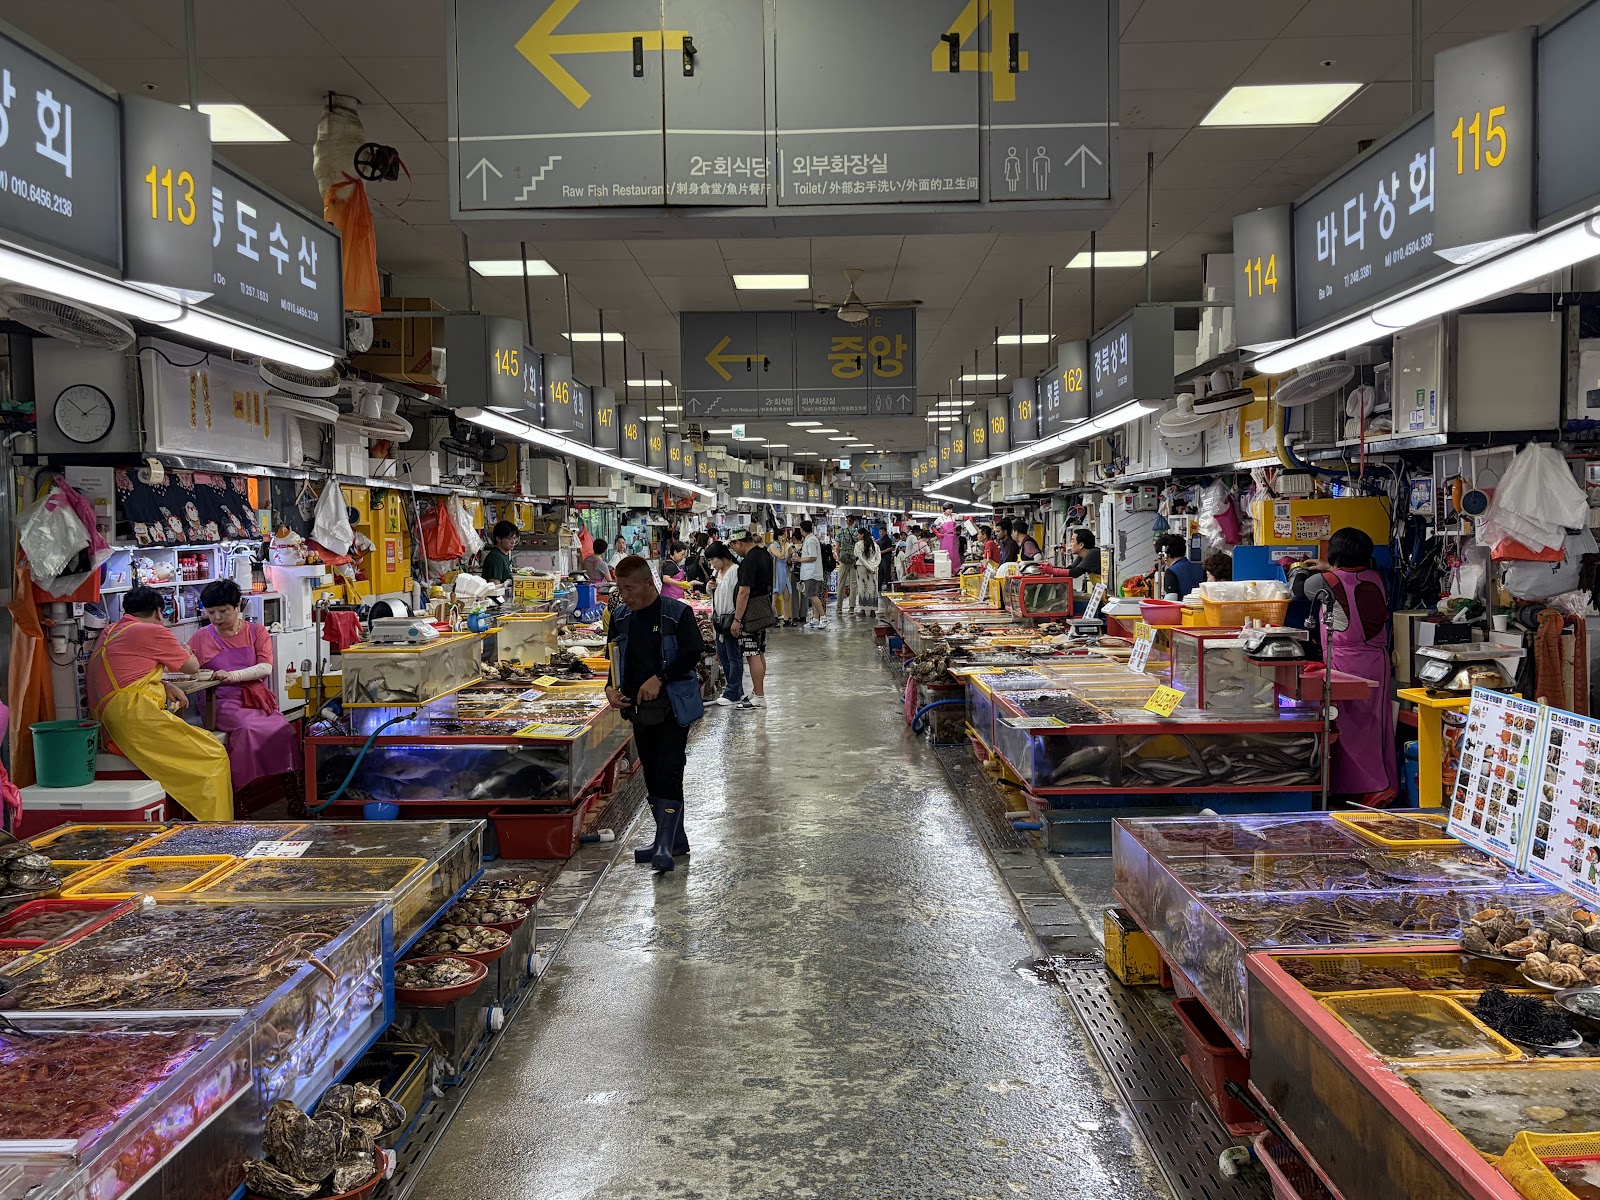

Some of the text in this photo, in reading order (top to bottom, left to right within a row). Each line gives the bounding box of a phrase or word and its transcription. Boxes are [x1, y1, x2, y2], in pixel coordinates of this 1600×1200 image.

[931, 0, 1029, 101] 4
[1451, 105, 1507, 176] 115
[690, 156, 771, 177] 2F회식당
[792, 153, 888, 176] 외부화장실
[11, 176, 72, 217] 010.6456.2138
[145, 164, 196, 226] 113
[562, 185, 584, 197] Raw
[588, 183, 609, 197] Fish
[793, 181, 827, 195] Toilet/
[1317, 147, 1434, 266] 바다상회
[1393, 233, 1434, 263] 010.4504.338
[1244, 254, 1278, 297] 114
[495, 349, 519, 377] 145
[828, 335, 908, 378] 중앙
[1095, 333, 1128, 383] 경북상회
[1063, 367, 1083, 393] 162
[550, 381, 569, 405] 146
[598, 408, 613, 427] 147
[1018, 401, 1032, 420] 161
[624, 423, 638, 440] 148
[991, 416, 1005, 434] 160
[650, 437, 662, 452] 149
[973, 428, 985, 444] 159
[670, 448, 681, 461] 150
[941, 447, 951, 460] 157
[953, 439, 964, 453] 158
[684, 455, 693, 467] 151
[699, 463, 708, 474] 152
[928, 457, 937, 469] 156
[514, 580, 547, 589] 킹크랩
